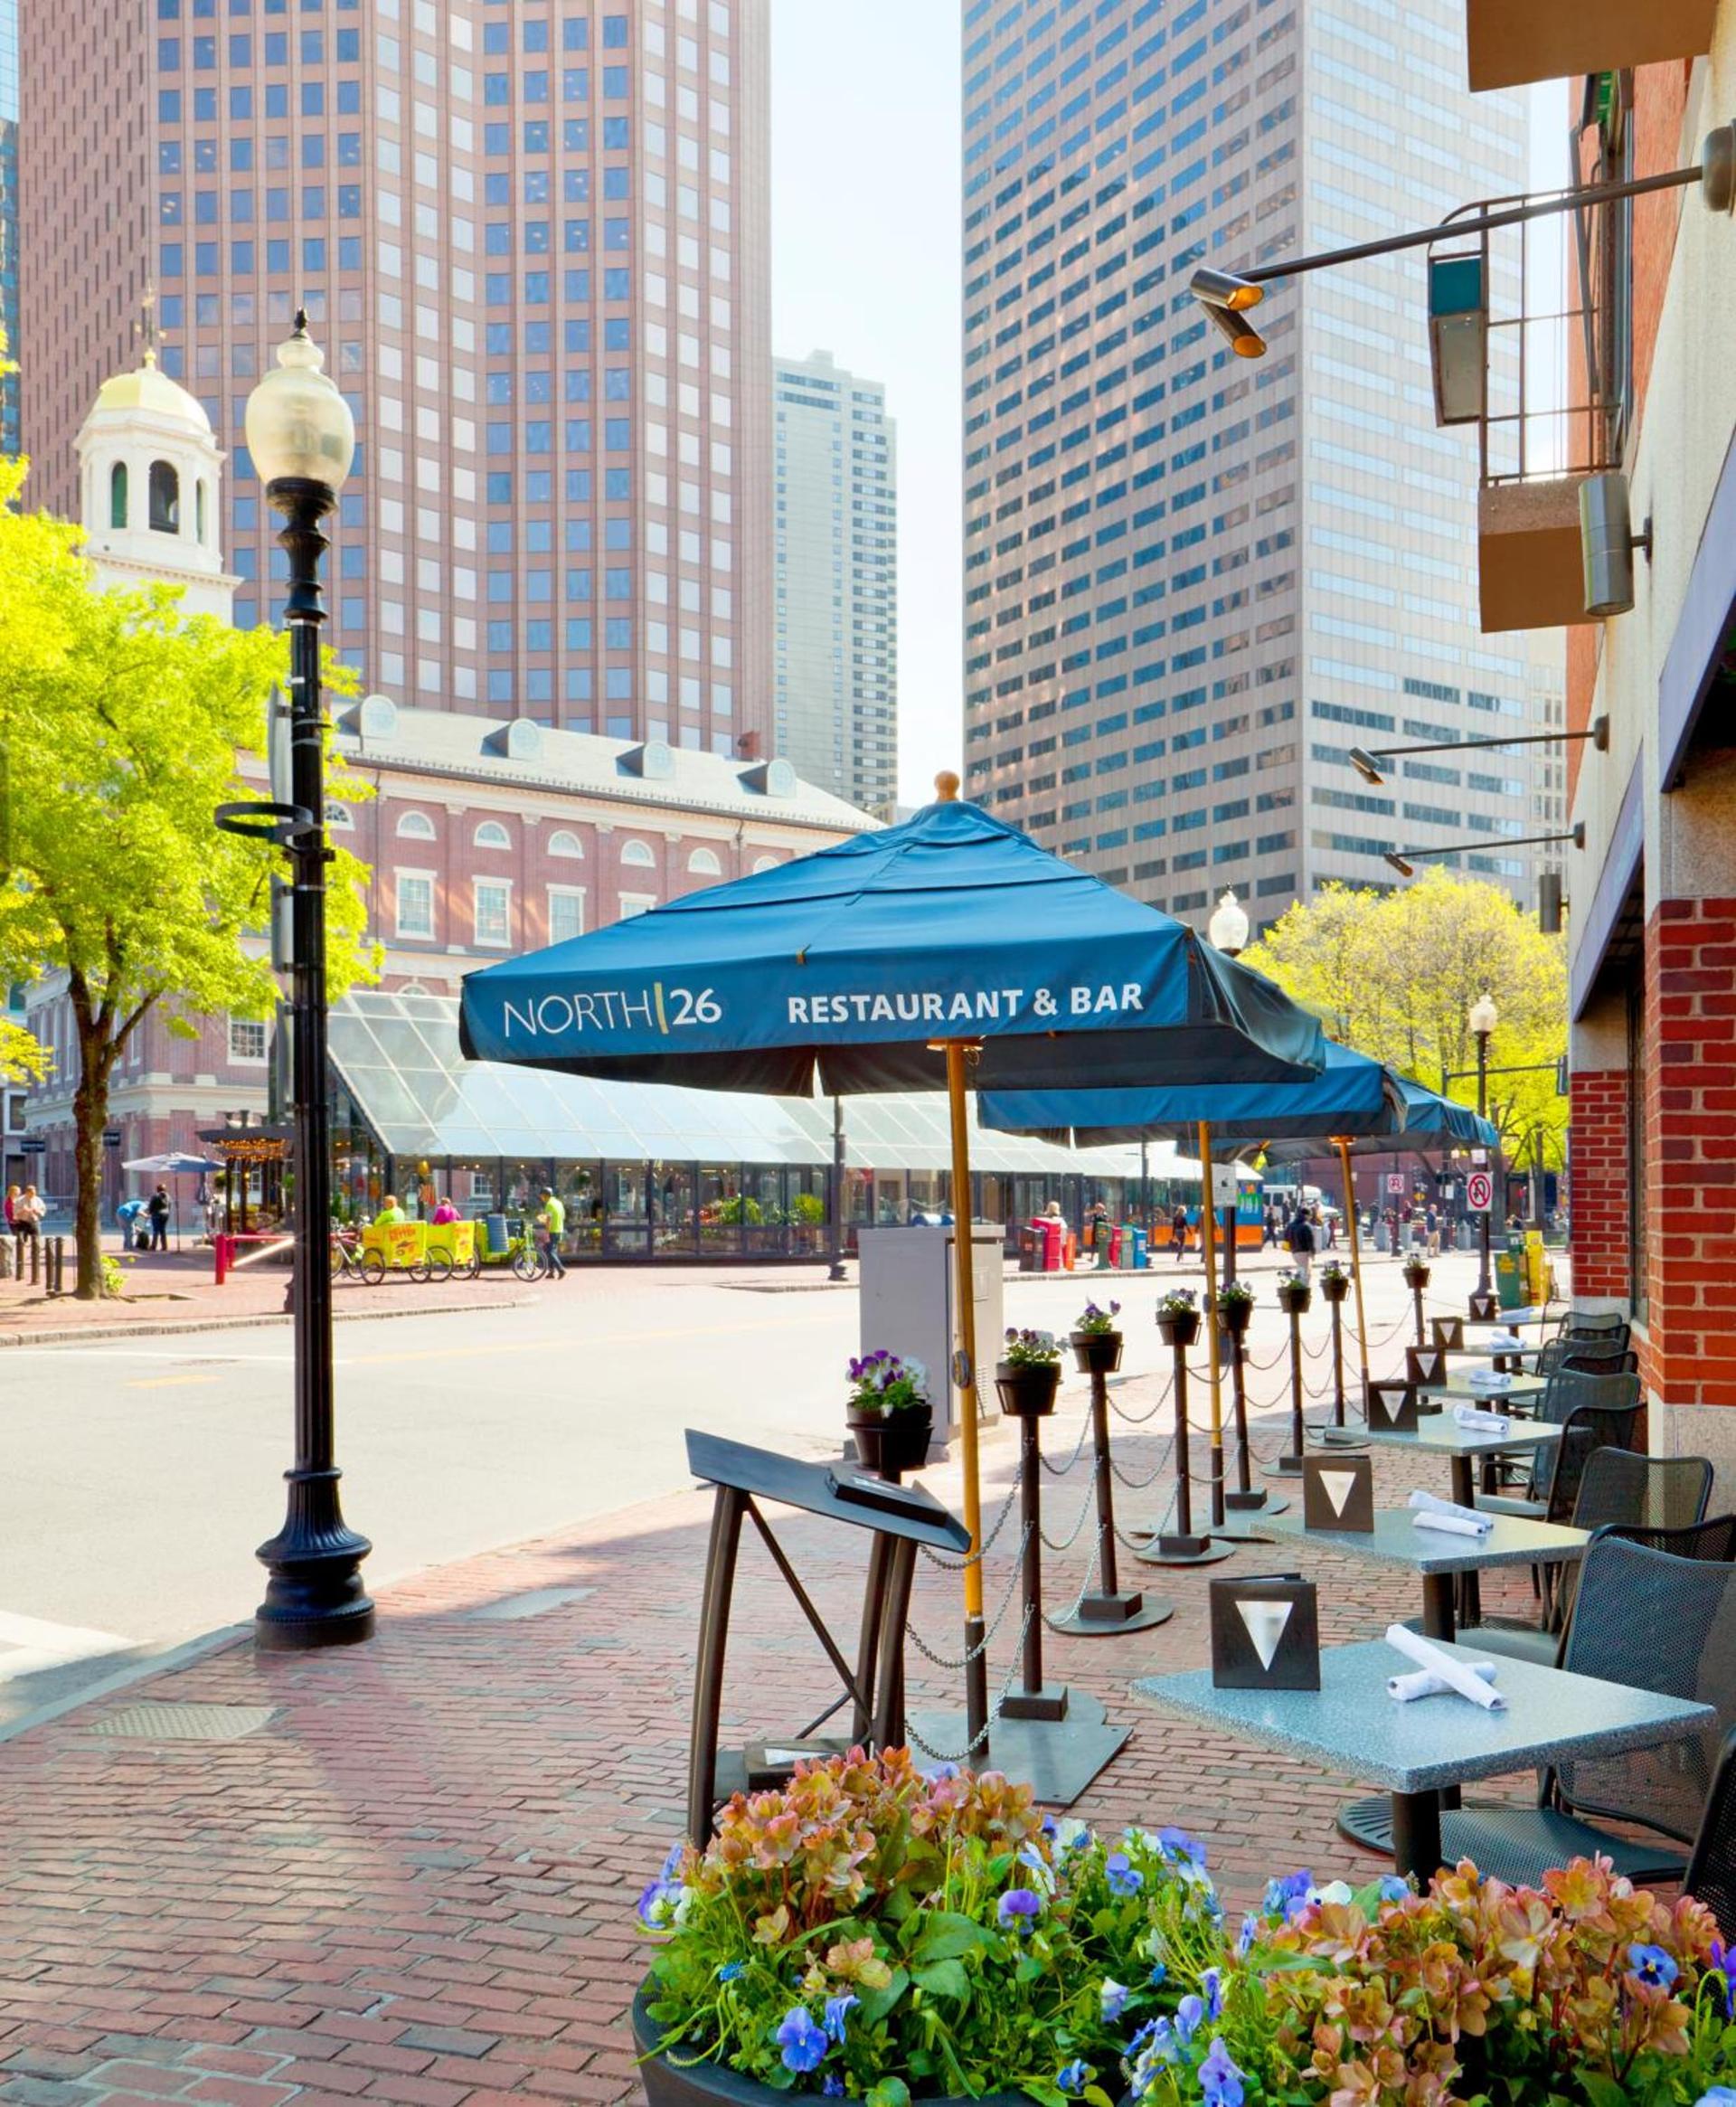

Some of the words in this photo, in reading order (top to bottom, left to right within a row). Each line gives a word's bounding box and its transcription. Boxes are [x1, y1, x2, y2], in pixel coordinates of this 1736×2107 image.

[788, 989, 1023, 1024] RESTAURANT
[1033, 987, 1058, 1016] &
[1071, 983, 1144, 1015] BAR
